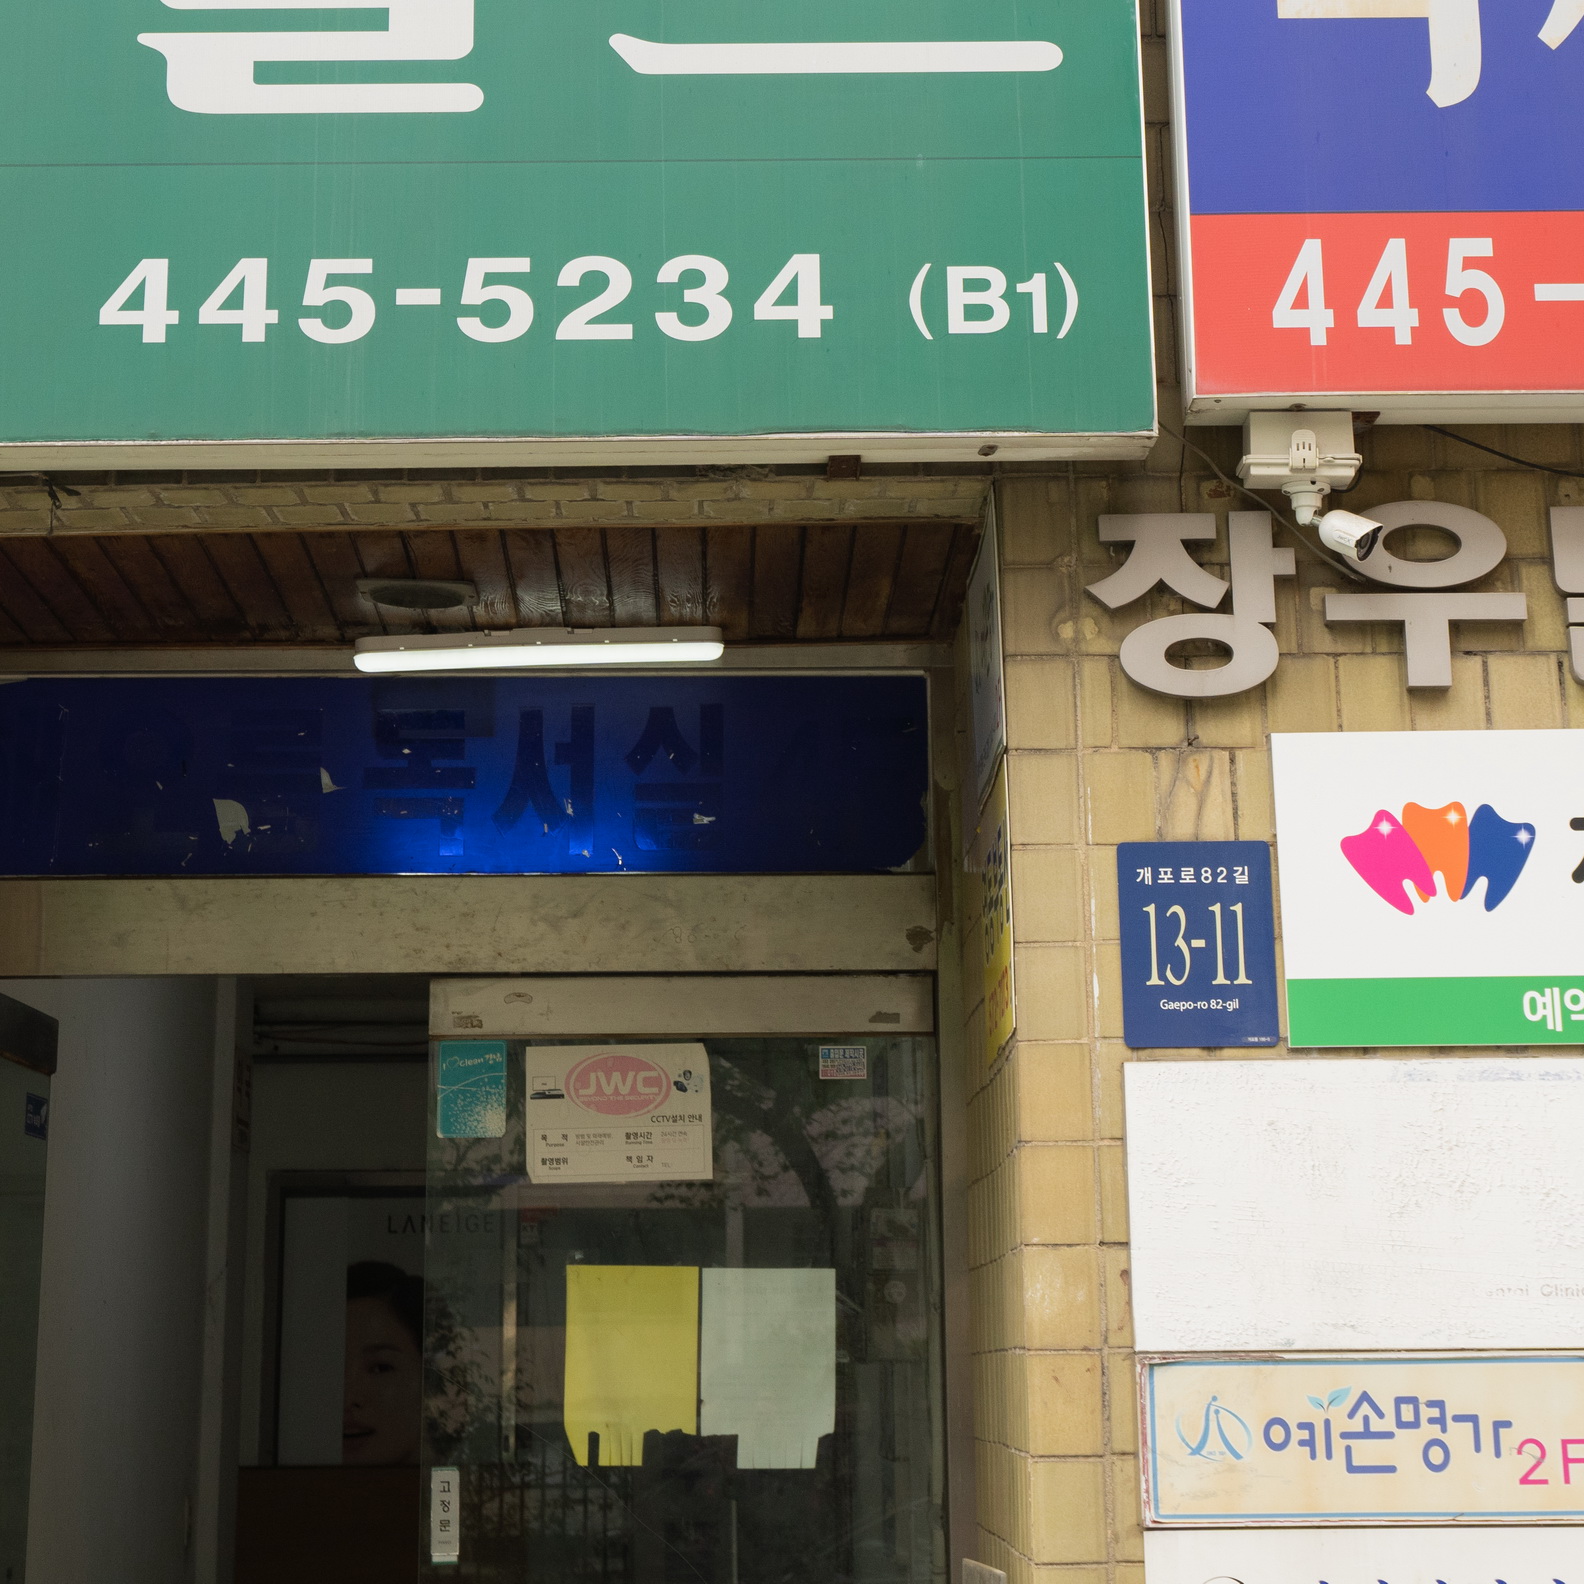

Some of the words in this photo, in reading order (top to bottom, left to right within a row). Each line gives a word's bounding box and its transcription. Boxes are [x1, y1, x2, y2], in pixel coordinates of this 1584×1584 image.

[99, 253, 834, 343] 445-5234
[908, 261, 1081, 340] (B1)
[1135, 865, 1250, 886] 개포로82길
[1142, 902, 1253, 986] 13-11
[1160, 999, 1208, 1012] Gaepo-ro
[1210, 998, 1239, 1012] 82-gil
[578, 1069, 660, 1096] JWC
[1262, 1389, 1513, 1475] 예손명가
[439, 1480, 452, 1533] 고정문
